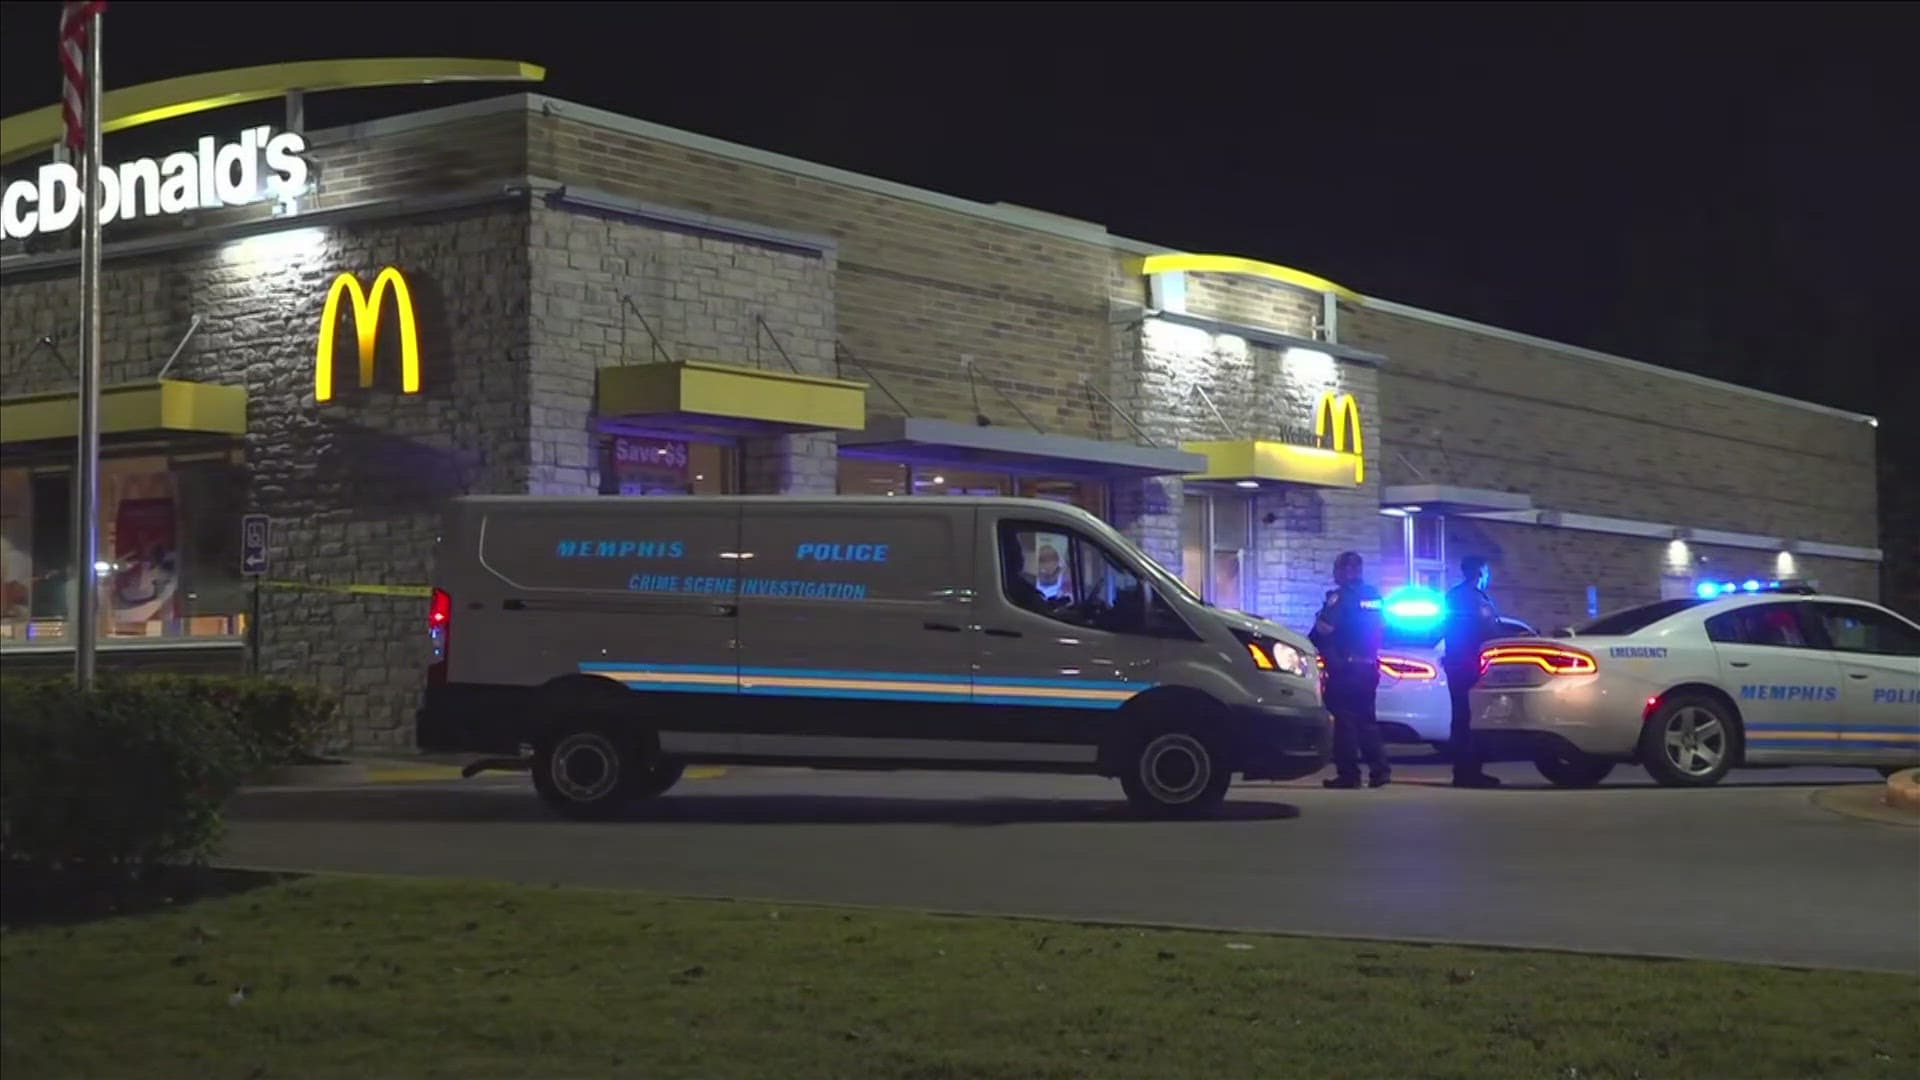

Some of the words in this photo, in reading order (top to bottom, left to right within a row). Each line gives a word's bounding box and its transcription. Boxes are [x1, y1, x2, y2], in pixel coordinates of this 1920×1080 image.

[0, 126, 307, 240] cDonald's
[556, 540, 684, 558] MEMPHIS
[796, 543, 888, 562] POLICE
[628, 574, 680, 592] CRIME
[683, 576, 737, 594] SCENE
[741, 578, 867, 599] INVESTIGATION
[1740, 685, 1838, 701] MEMPHIS
